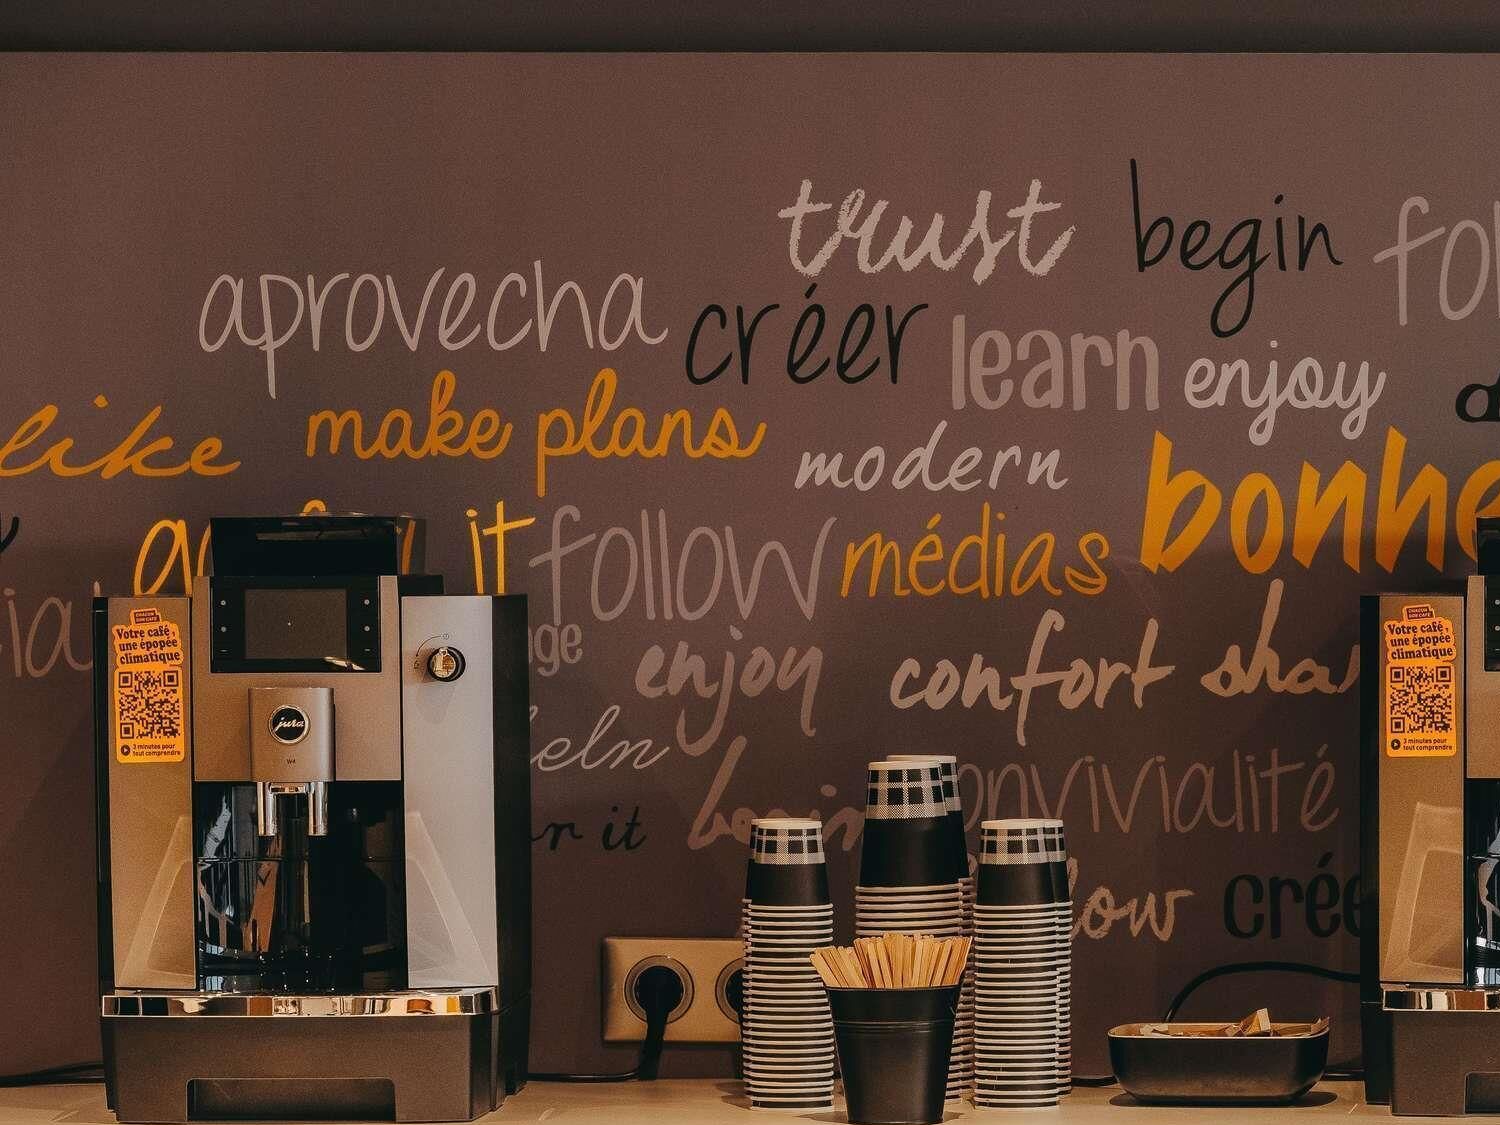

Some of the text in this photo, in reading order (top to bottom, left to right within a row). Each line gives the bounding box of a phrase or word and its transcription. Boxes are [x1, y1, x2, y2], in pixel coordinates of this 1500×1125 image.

[777, 178, 1077, 285] trust
[1130, 158, 1344, 338] begin
[199, 259, 669, 399] aprovecha
[684, 282, 930, 385] créer
[951, 314, 1161, 412] learn
[306, 366, 767, 498] make plans
[1184, 340, 1387, 446] enjoy
[0, 394, 242, 480] like
[794, 420, 1070, 492] modern
[466, 499, 535, 595] it
[530, 504, 837, 625] follow
[840, 502, 1112, 599] médias
[116, 627, 145, 640] Votre
[119, 637, 178, 652] une épopée
[119, 651, 181, 665] climatique
[1388, 623, 1418, 635] Votre
[1390, 633, 1451, 647] une épopée
[1391, 646, 1453, 660] climatique
[634, 624, 821, 757] enjoy
[888, 608, 1176, 746] confort
[145, 749, 181, 757] comprendre
[161, 743, 176, 752] pour
[273, 716, 305, 733] jura
[1416, 743, 1453, 752] comprendre
[1432, 738, 1447, 746] pour
[601, 804, 646, 852] it
